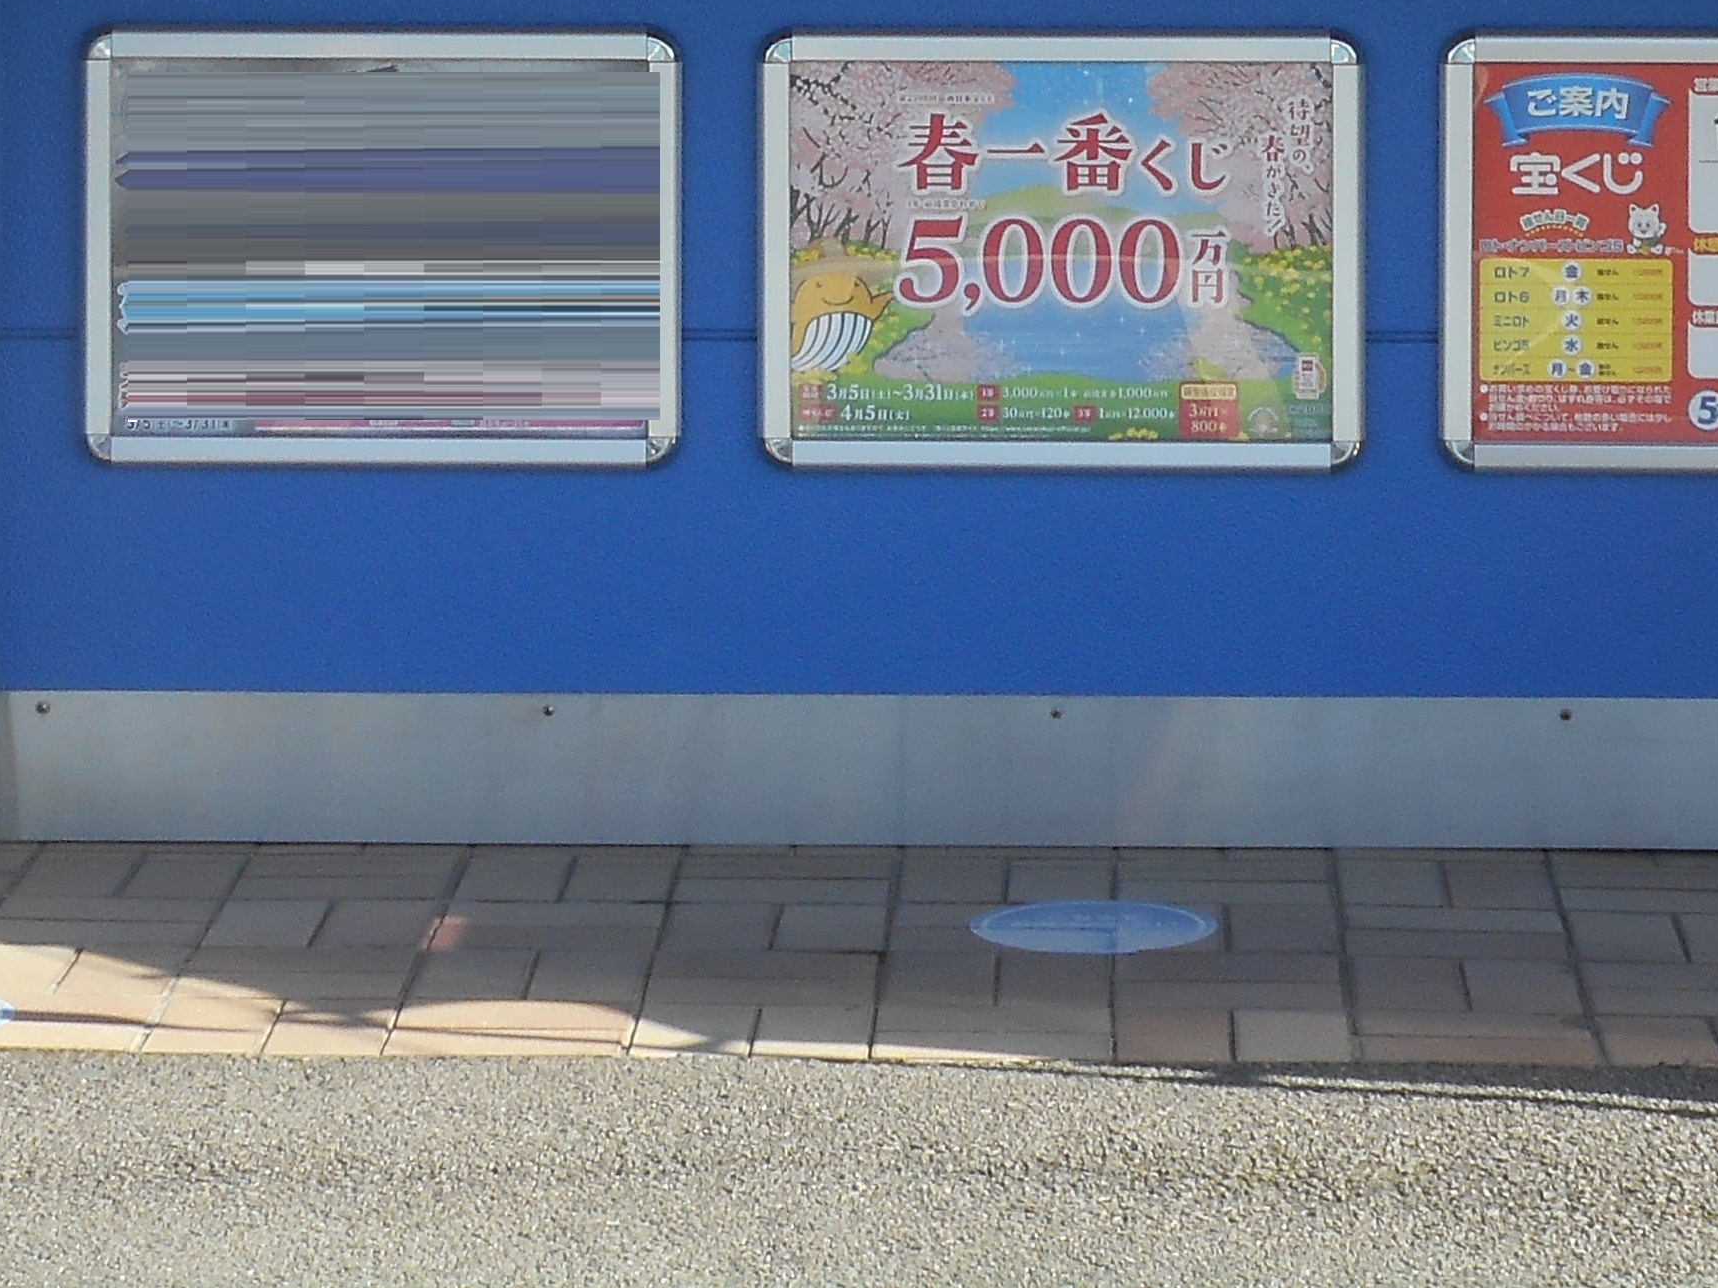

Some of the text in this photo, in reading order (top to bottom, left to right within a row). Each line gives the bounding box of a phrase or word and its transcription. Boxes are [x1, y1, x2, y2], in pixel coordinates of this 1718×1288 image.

[1526, 85, 1629, 120] ご案内
[897, 111, 1228, 193] 春一番くじ
[1510, 152, 1644, 195] 宝くじ
